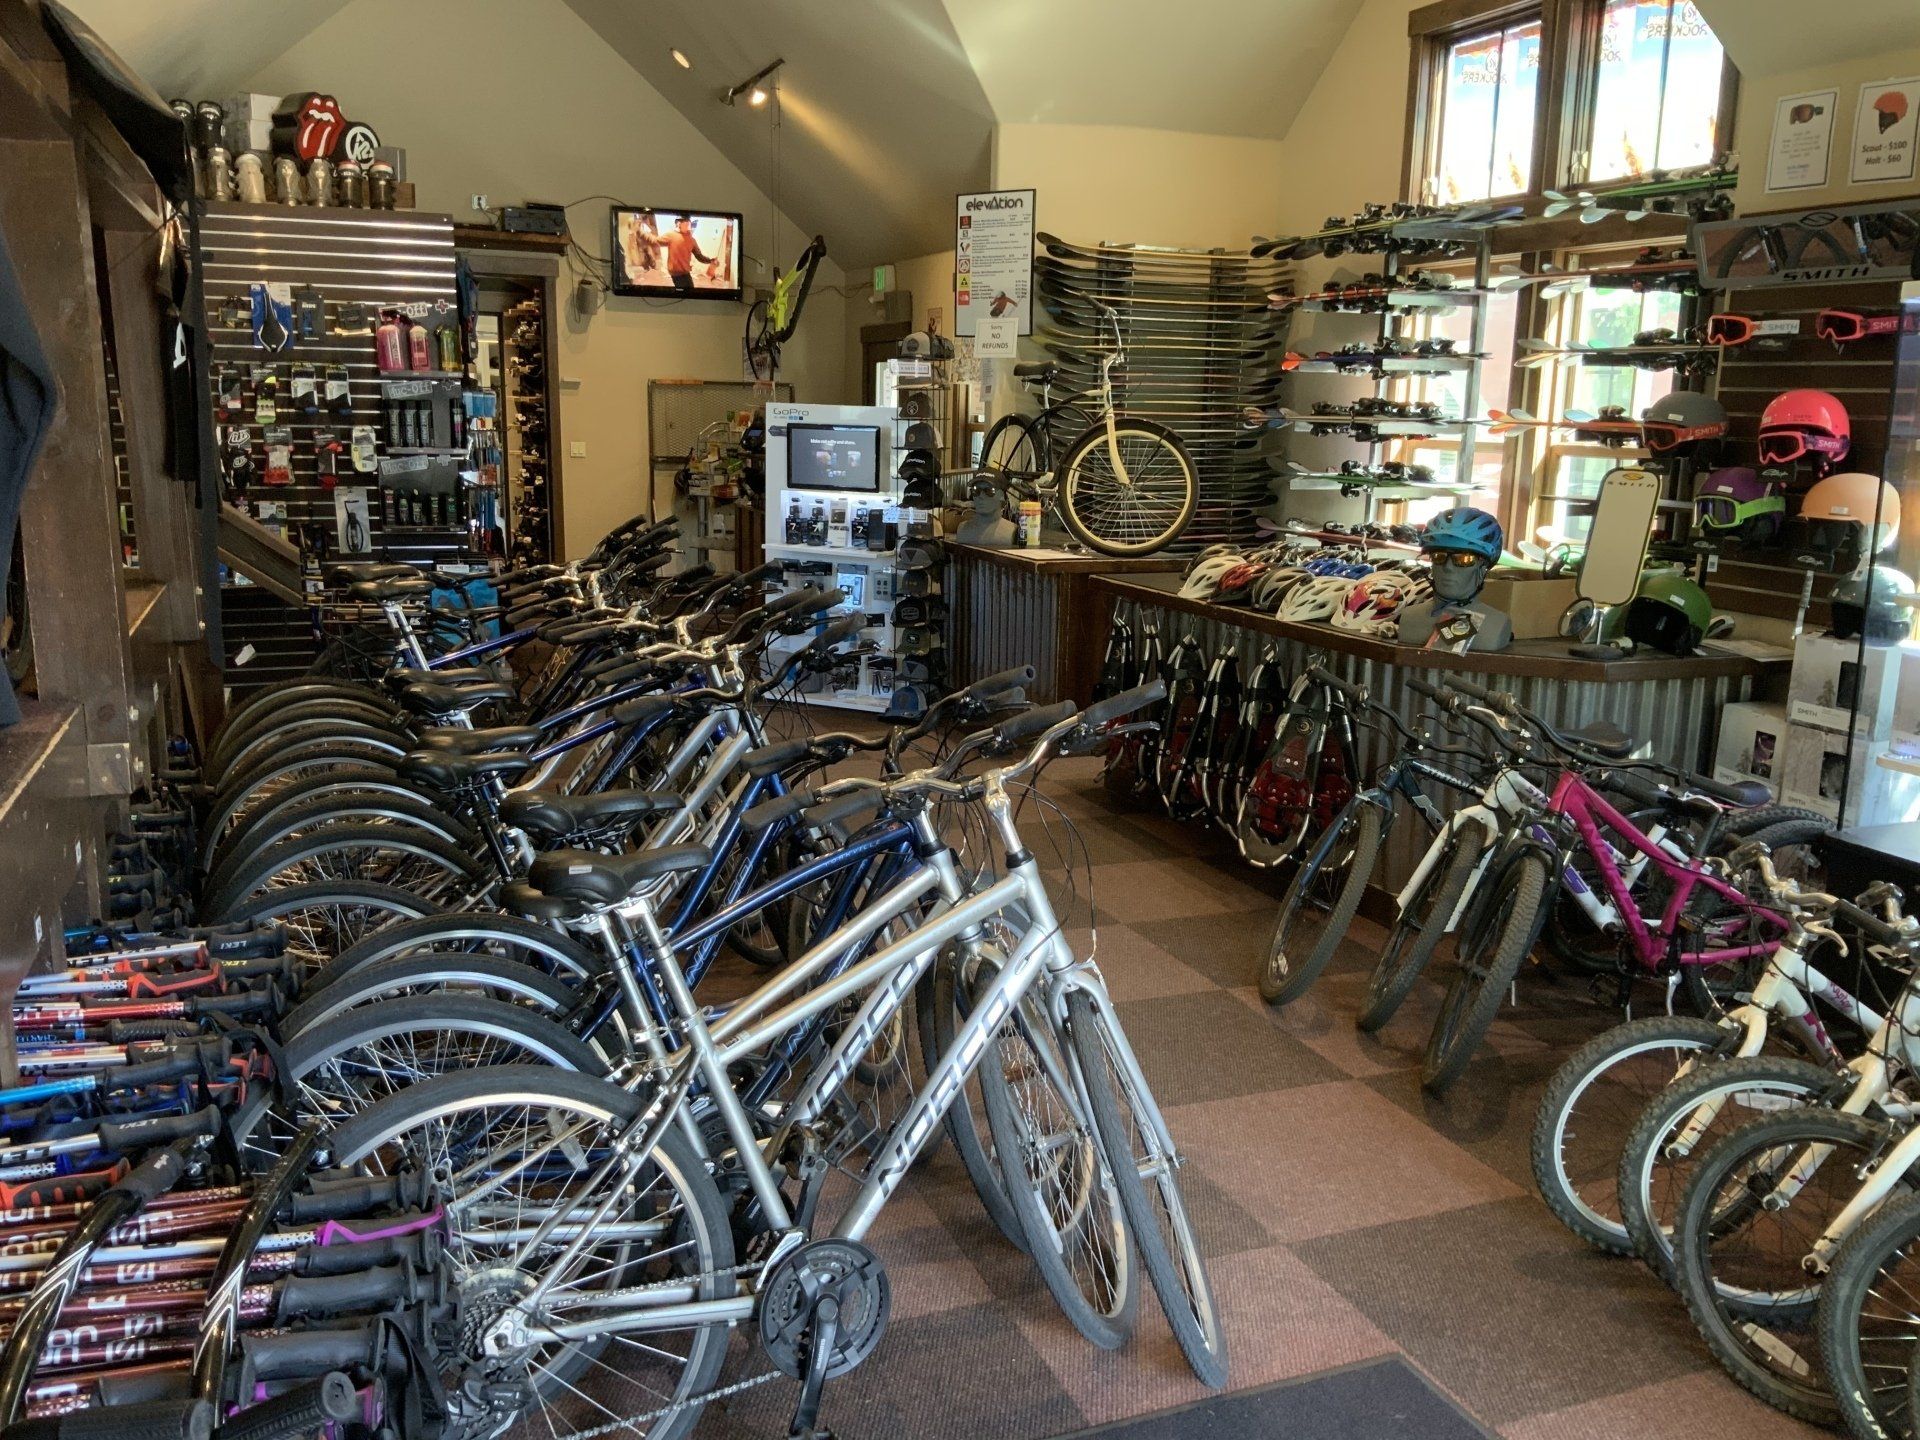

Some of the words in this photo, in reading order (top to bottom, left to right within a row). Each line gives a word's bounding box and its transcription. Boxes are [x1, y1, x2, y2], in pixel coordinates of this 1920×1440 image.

[1861, 144, 1882, 153] Scout
[1888, 140, 1908, 151] $100
[1887, 154, 1902, 164] $60
[1783, 266, 1870, 281] SMITH
[1767, 321, 1798, 331] SMITH
[773, 407, 810, 416] GoPro
[1695, 426, 1719, 436] SMITH
[1818, 440, 1840, 448] SMITH
[856, 526, 863, 534] 7
[1797, 706, 1818, 717] SMITH
[220, 940, 248, 950] LEKI
[806, 955, 919, 1123] NORCO
[143, 1045, 178, 1053] LEKI
[877, 987, 1010, 1200] NORCO
[119, 1118, 158, 1130] LEKI
